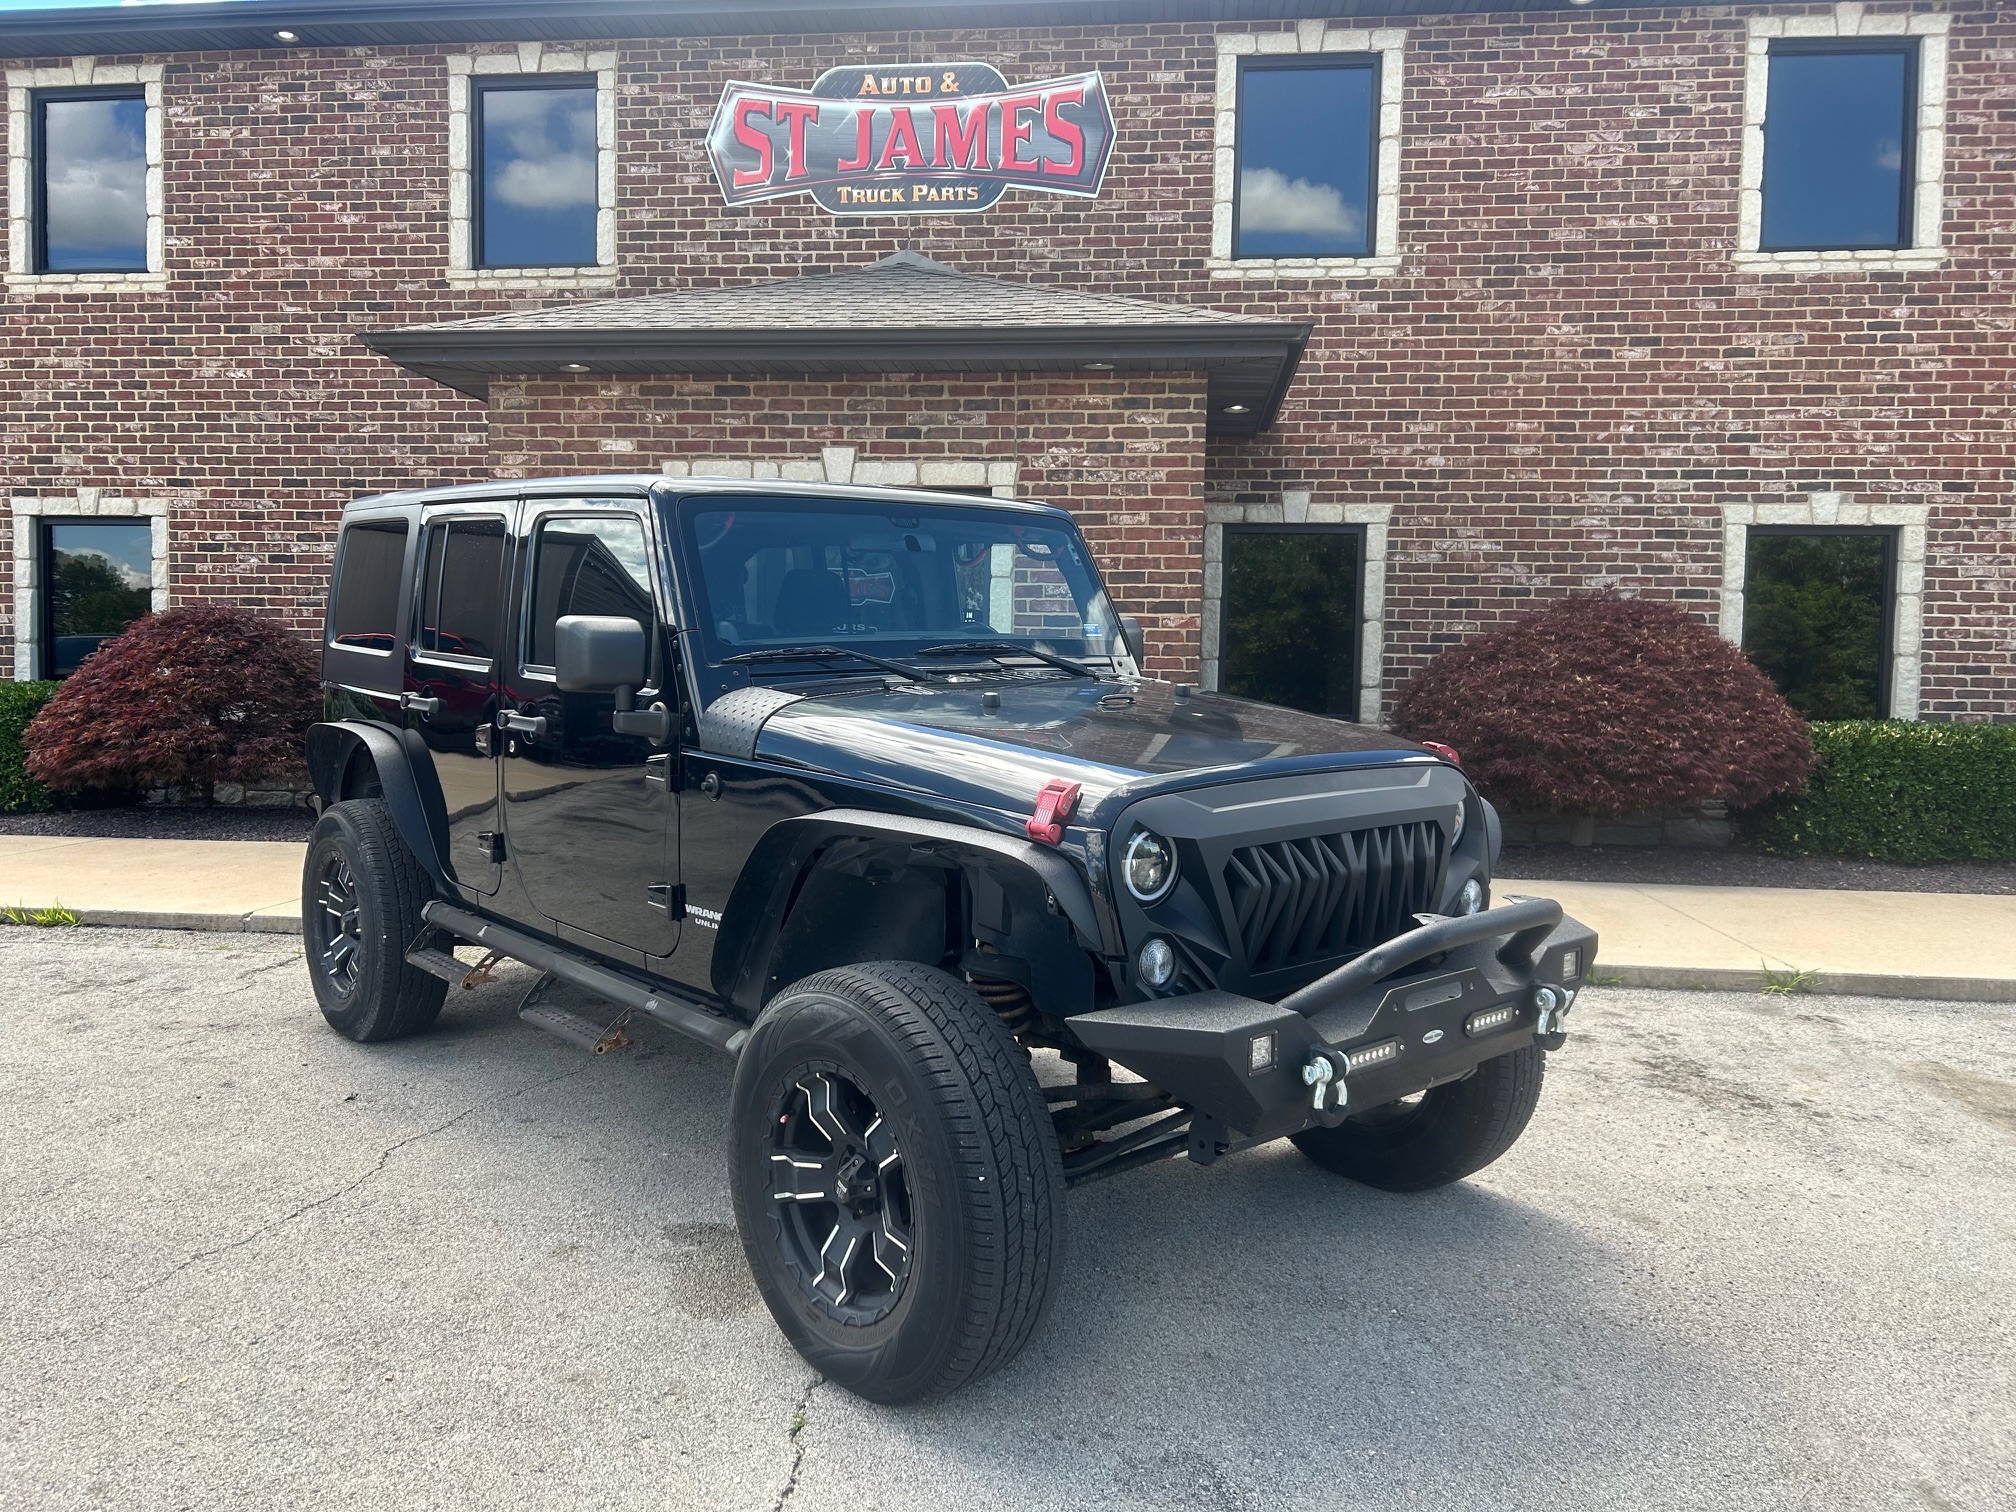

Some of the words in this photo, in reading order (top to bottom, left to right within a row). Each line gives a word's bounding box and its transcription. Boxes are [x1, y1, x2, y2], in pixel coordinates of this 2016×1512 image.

[857, 73, 932, 95] AUTO
[940, 71, 960, 93] &
[733, 98, 820, 187] ST
[837, 88, 1086, 175] JAMES
[836, 186, 905, 204] TRUCK
[912, 184, 979, 202] PARTS
